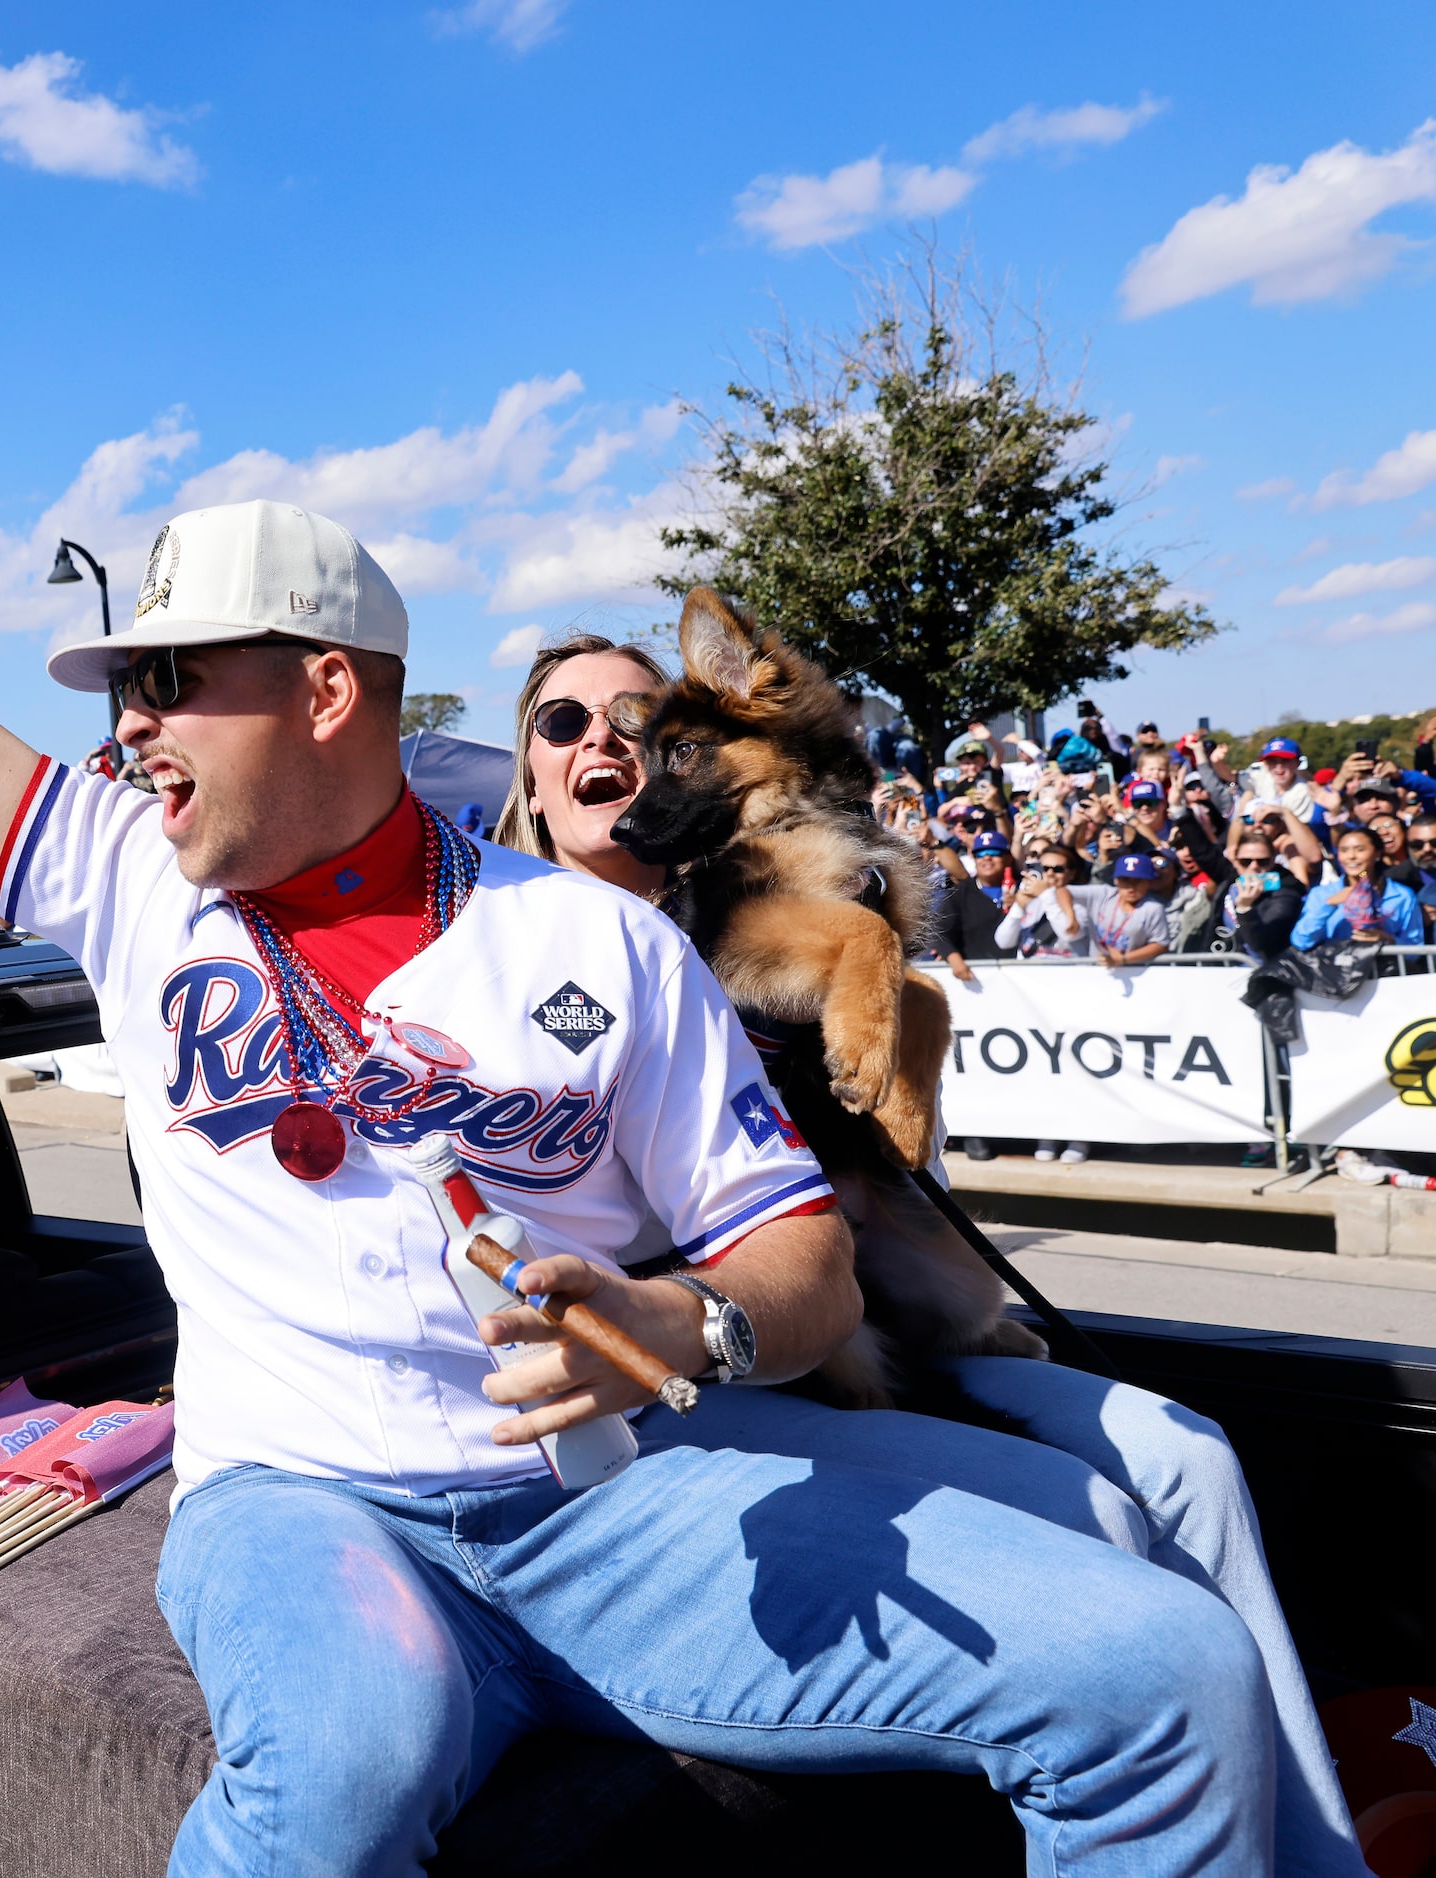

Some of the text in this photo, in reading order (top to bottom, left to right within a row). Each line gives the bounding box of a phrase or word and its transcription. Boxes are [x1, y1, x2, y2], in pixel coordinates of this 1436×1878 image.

[542, 1005, 605, 1018] WORLD
[543, 1017, 606, 1031] SERIES
[158, 956, 621, 1166] Rangers
[953, 1027, 1233, 1086] TOYOTA
